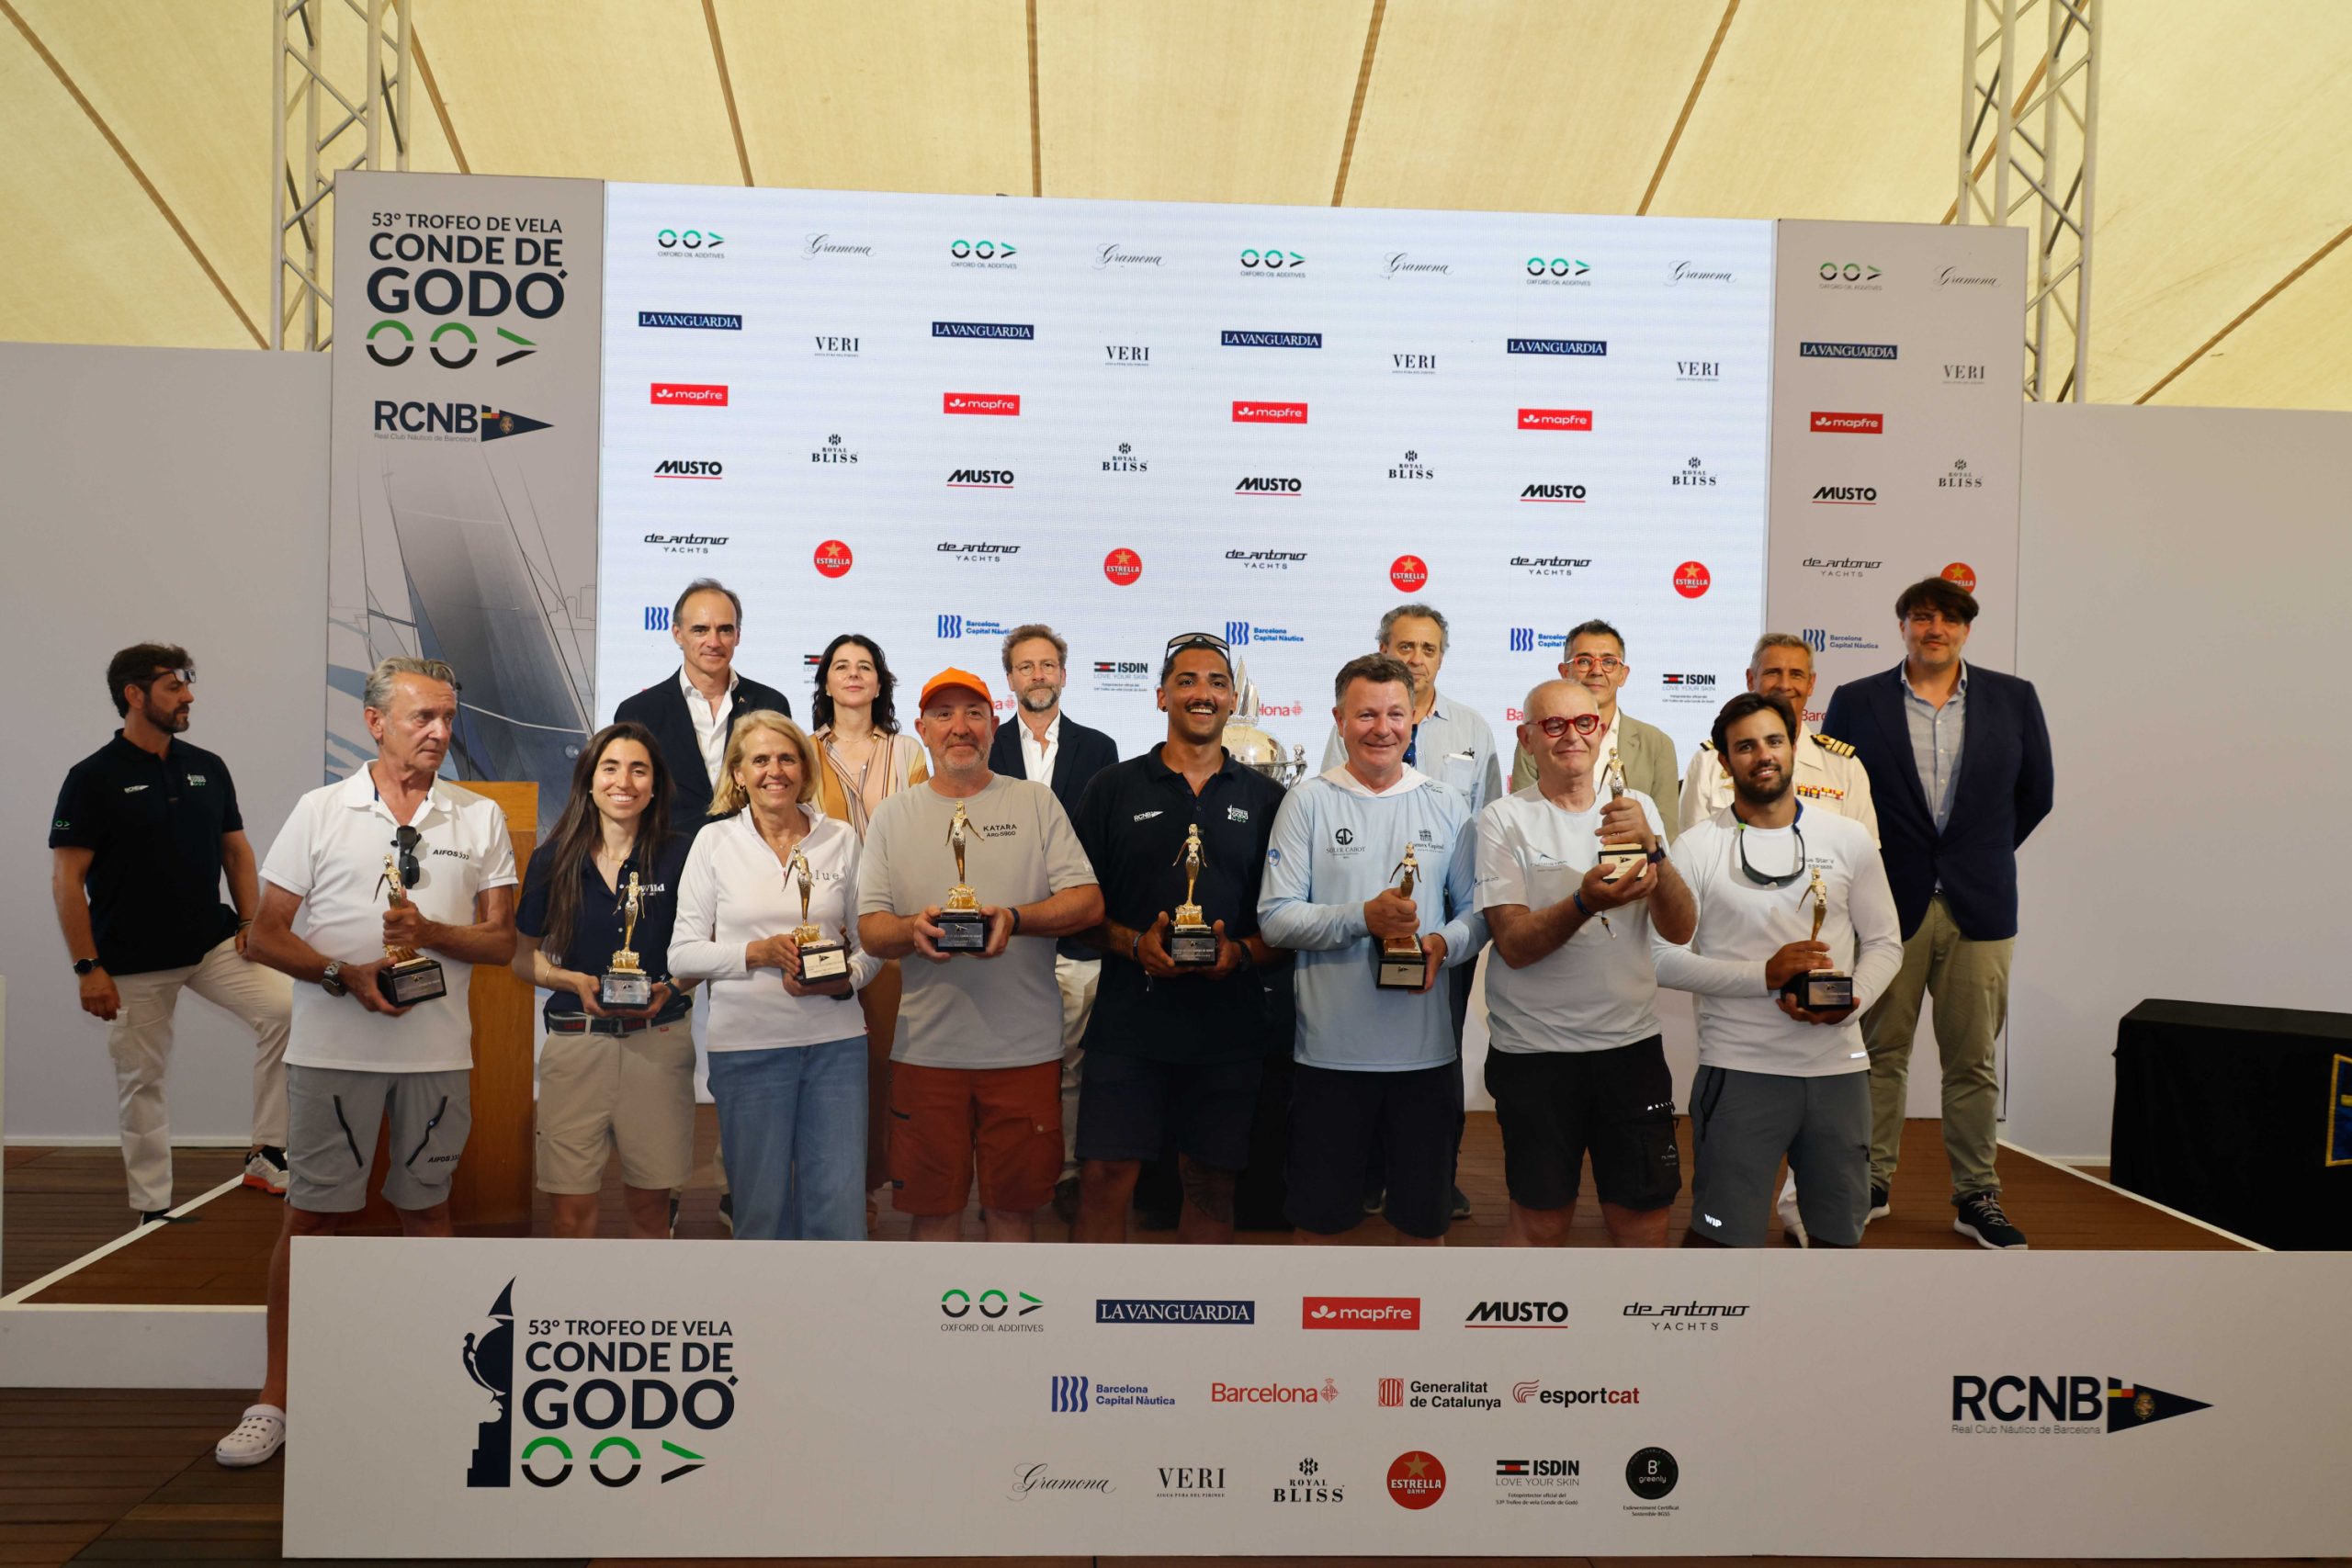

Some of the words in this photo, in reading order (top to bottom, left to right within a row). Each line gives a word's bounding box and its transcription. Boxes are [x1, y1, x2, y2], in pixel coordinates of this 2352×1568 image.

[405, 213, 481, 231] TROFEO
[486, 216, 512, 232] DE
[514, 217, 563, 234] VELA
[368, 231, 505, 265] CONDE
[514, 237, 563, 267] DE
[806, 231, 874, 260] Gramona
[1097, 243, 1165, 268] Gramona
[1384, 251, 1453, 278] Gramona
[1667, 259, 1736, 285] Gramona
[1936, 265, 2001, 288] Gramona
[656, 314, 739, 328] VANGUARDIA
[950, 324, 1030, 338] VANGUARDIA
[815, 336, 859, 352] VERI
[1238, 333, 1318, 346] VANGUARDIA
[1105, 345, 1149, 361] VERI
[1524, 342, 1604, 355] VANGUARDIA
[1816, 344, 1894, 357] VANGUARDIA
[1393, 354, 1436, 369] VERI
[1677, 361, 1719, 377] VERI
[1943, 364, 1985, 379] VERI
[675, 389, 723, 401] mapfre
[967, 399, 1015, 412] mapfre
[374, 400, 479, 434] RCNB
[1256, 407, 1303, 419] mapfre
[1542, 414, 1588, 426] mapfre
[1833, 417, 1879, 429] mapfre
[811, 452, 858, 464] BLISS
[653, 460, 723, 476] MUSTO
[1102, 461, 1148, 472] BLISS
[1388, 467, 1434, 479] BLISS
[946, 469, 1015, 485] MUSTO
[1672, 475, 1716, 486] BLISS
[1938, 477, 1983, 488] BLISS
[1235, 477, 1302, 492] MUSTO
[1521, 484, 1587, 500] MUSTO
[1812, 486, 1878, 502] MUSTO
[662, 547, 709, 555] YACHTS
[816, 558, 851, 566] ESTRELLA
[956, 555, 1001, 563] YACHTS
[1105, 565, 1140, 574] ESTRELLA
[1243, 562, 1288, 570] YACHTS
[1392, 572, 1426, 581] ESTRELLA
[1528, 569, 1572, 577] YACHTS
[1820, 570, 1863, 578] YACHTS
[1675, 578, 1709, 586] ESTRELLA
[1118, 662, 1148, 672] ISDIN
[1686, 674, 1715, 684] ISDIN
[983, 823, 1017, 832] KATARA
[1704, 1213, 1722, 1227] WIP
[1101, 1303, 1127, 1320] LA
[1127, 1303, 1250, 1321] VANGUARDIA
[1340, 1305, 1413, 1323] mapfre
[1464, 1301, 1569, 1324] MUSTO
[564, 1319, 646, 1337] TROFEO
[650, 1320, 678, 1337] DE
[682, 1320, 733, 1337] VELA
[940, 1323, 979, 1333] OXFORD
[981, 1323, 995, 1333] OIL
[998, 1323, 1045, 1333] ADDITIVES
[1651, 1322, 1719, 1331] YACHTS
[525, 1340, 672, 1373] CONDE
[681, 1341, 734, 1373] DE
[1095, 1383, 1148, 1393] Barcelona
[1211, 1382, 1318, 1404] Barcelona
[1409, 1380, 1488, 1393] Generalitat
[1095, 1395, 1134, 1407] Capital
[1409, 1395, 1428, 1408] de
[1430, 1395, 1501, 1411] Catalunya
[1539, 1387, 1640, 1409] esportcat
[1951, 1374, 2104, 1422] RCNB
[1951, 1424, 1973, 1434] Real
[1975, 1424, 1997, 1434] Club
[2039, 1425, 2052, 1434] de
[2053, 1425, 2101, 1435] Barcelona
[1532, 1460, 1580, 1476] ISDIN
[1012, 1462, 1114, 1497] Gramona
[1158, 1467, 1225, 1489] VERI
[1289, 1479, 1326, 1487] ROYAL
[1390, 1479, 1442, 1490] ESTRELLA
[1495, 1477, 1522, 1487] LOVE
[1524, 1477, 1555, 1487] YOUR
[1556, 1477, 1580, 1487] SKIN
[1638, 1475, 1667, 1483] greenly
[1272, 1488, 1344, 1503] BLISS
